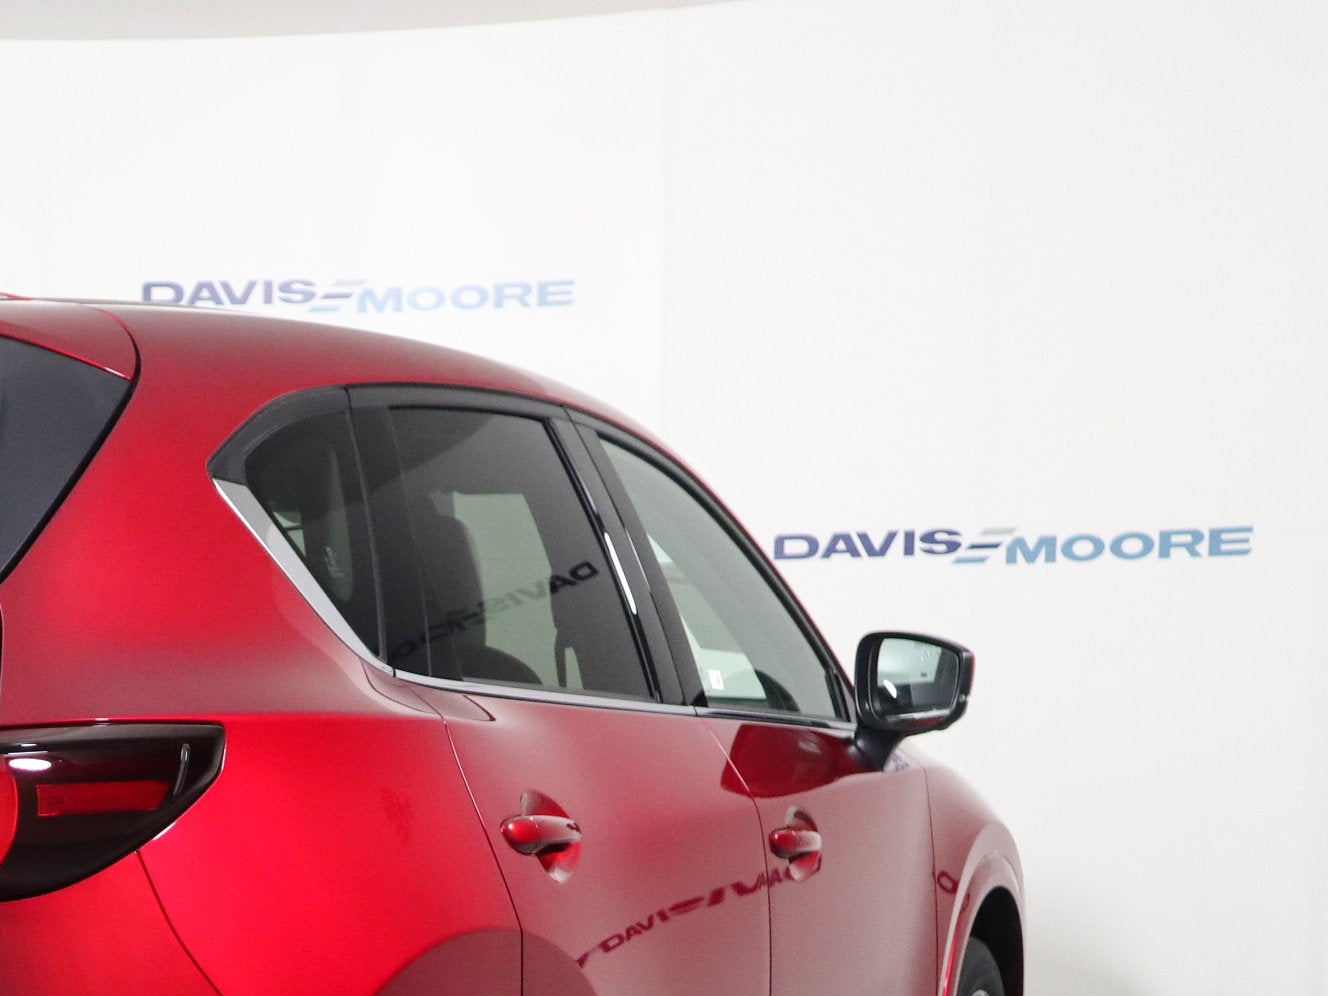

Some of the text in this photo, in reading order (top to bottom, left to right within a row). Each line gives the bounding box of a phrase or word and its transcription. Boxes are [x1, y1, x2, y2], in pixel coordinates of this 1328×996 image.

[142, 279, 576, 314] DAVIS MOORE
[774, 525, 1253, 564] DAVIS MOORE
